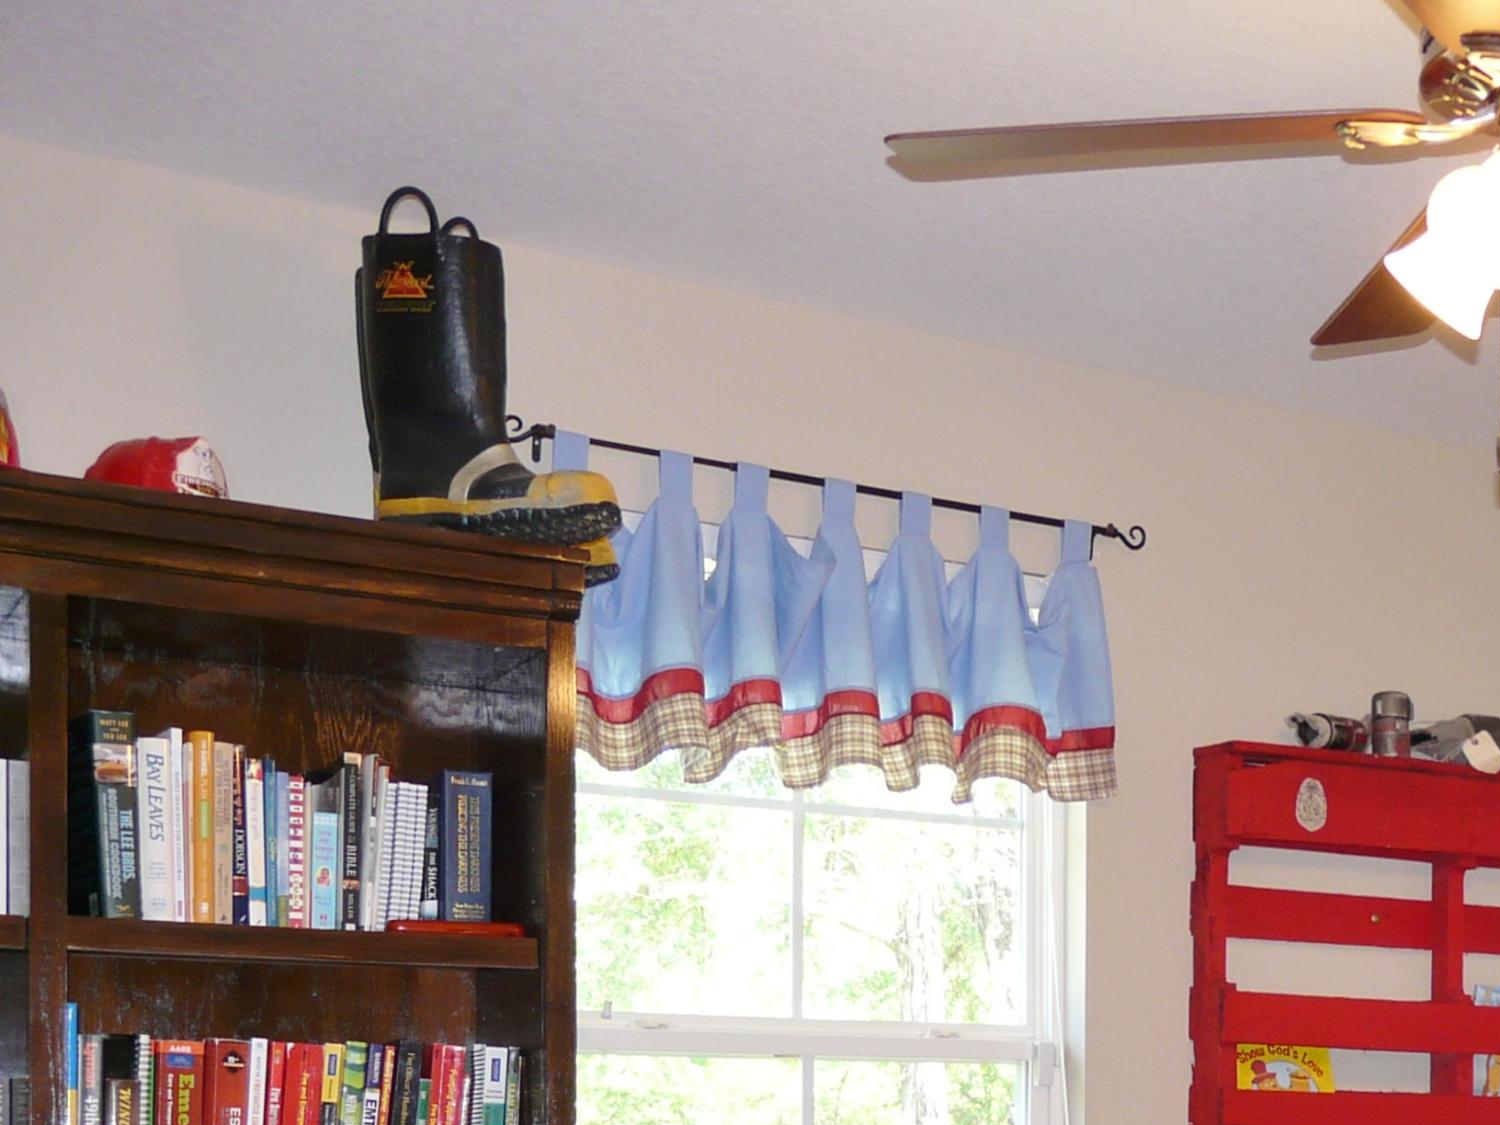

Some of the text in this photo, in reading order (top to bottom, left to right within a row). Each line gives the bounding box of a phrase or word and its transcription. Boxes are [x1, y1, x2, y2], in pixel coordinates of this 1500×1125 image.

[146, 753, 165, 783] BAY
[120, 810, 134, 829] THE
[148, 786, 165, 841] LEAVES
[121, 830, 134, 849] LEE
[234, 828, 245, 875] DOBSON
[346, 845, 357, 876] BIBLE
[428, 867, 437, 899] SHACK
[1237, 1044, 1324, 1077] Show God's Love
